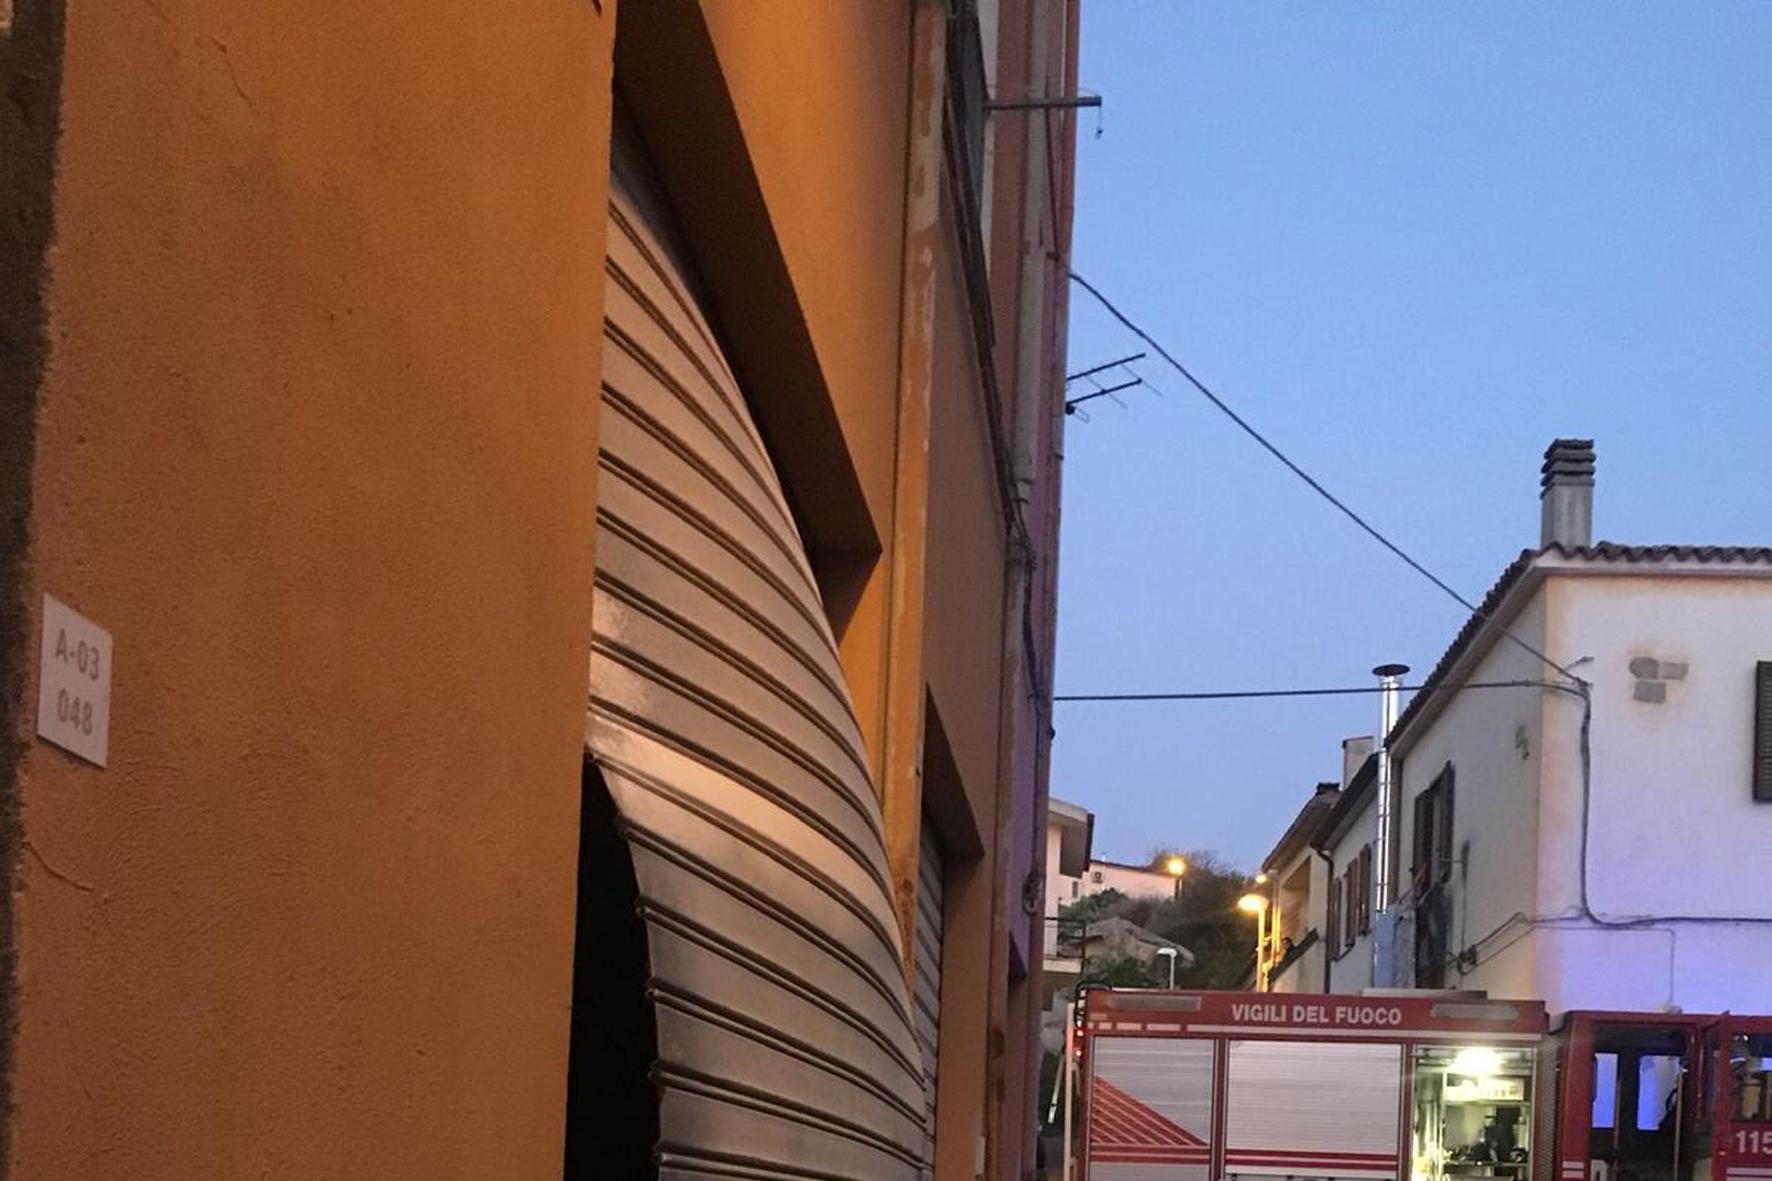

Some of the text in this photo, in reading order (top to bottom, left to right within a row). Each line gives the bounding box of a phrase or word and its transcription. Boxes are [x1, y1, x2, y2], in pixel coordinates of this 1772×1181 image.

[55, 628, 100, 680] A-03
[58, 688, 94, 736] 048
[1231, 1003, 1402, 1025] VIGILI DEL FUOCO
[1736, 1130, 1772, 1155] 115
